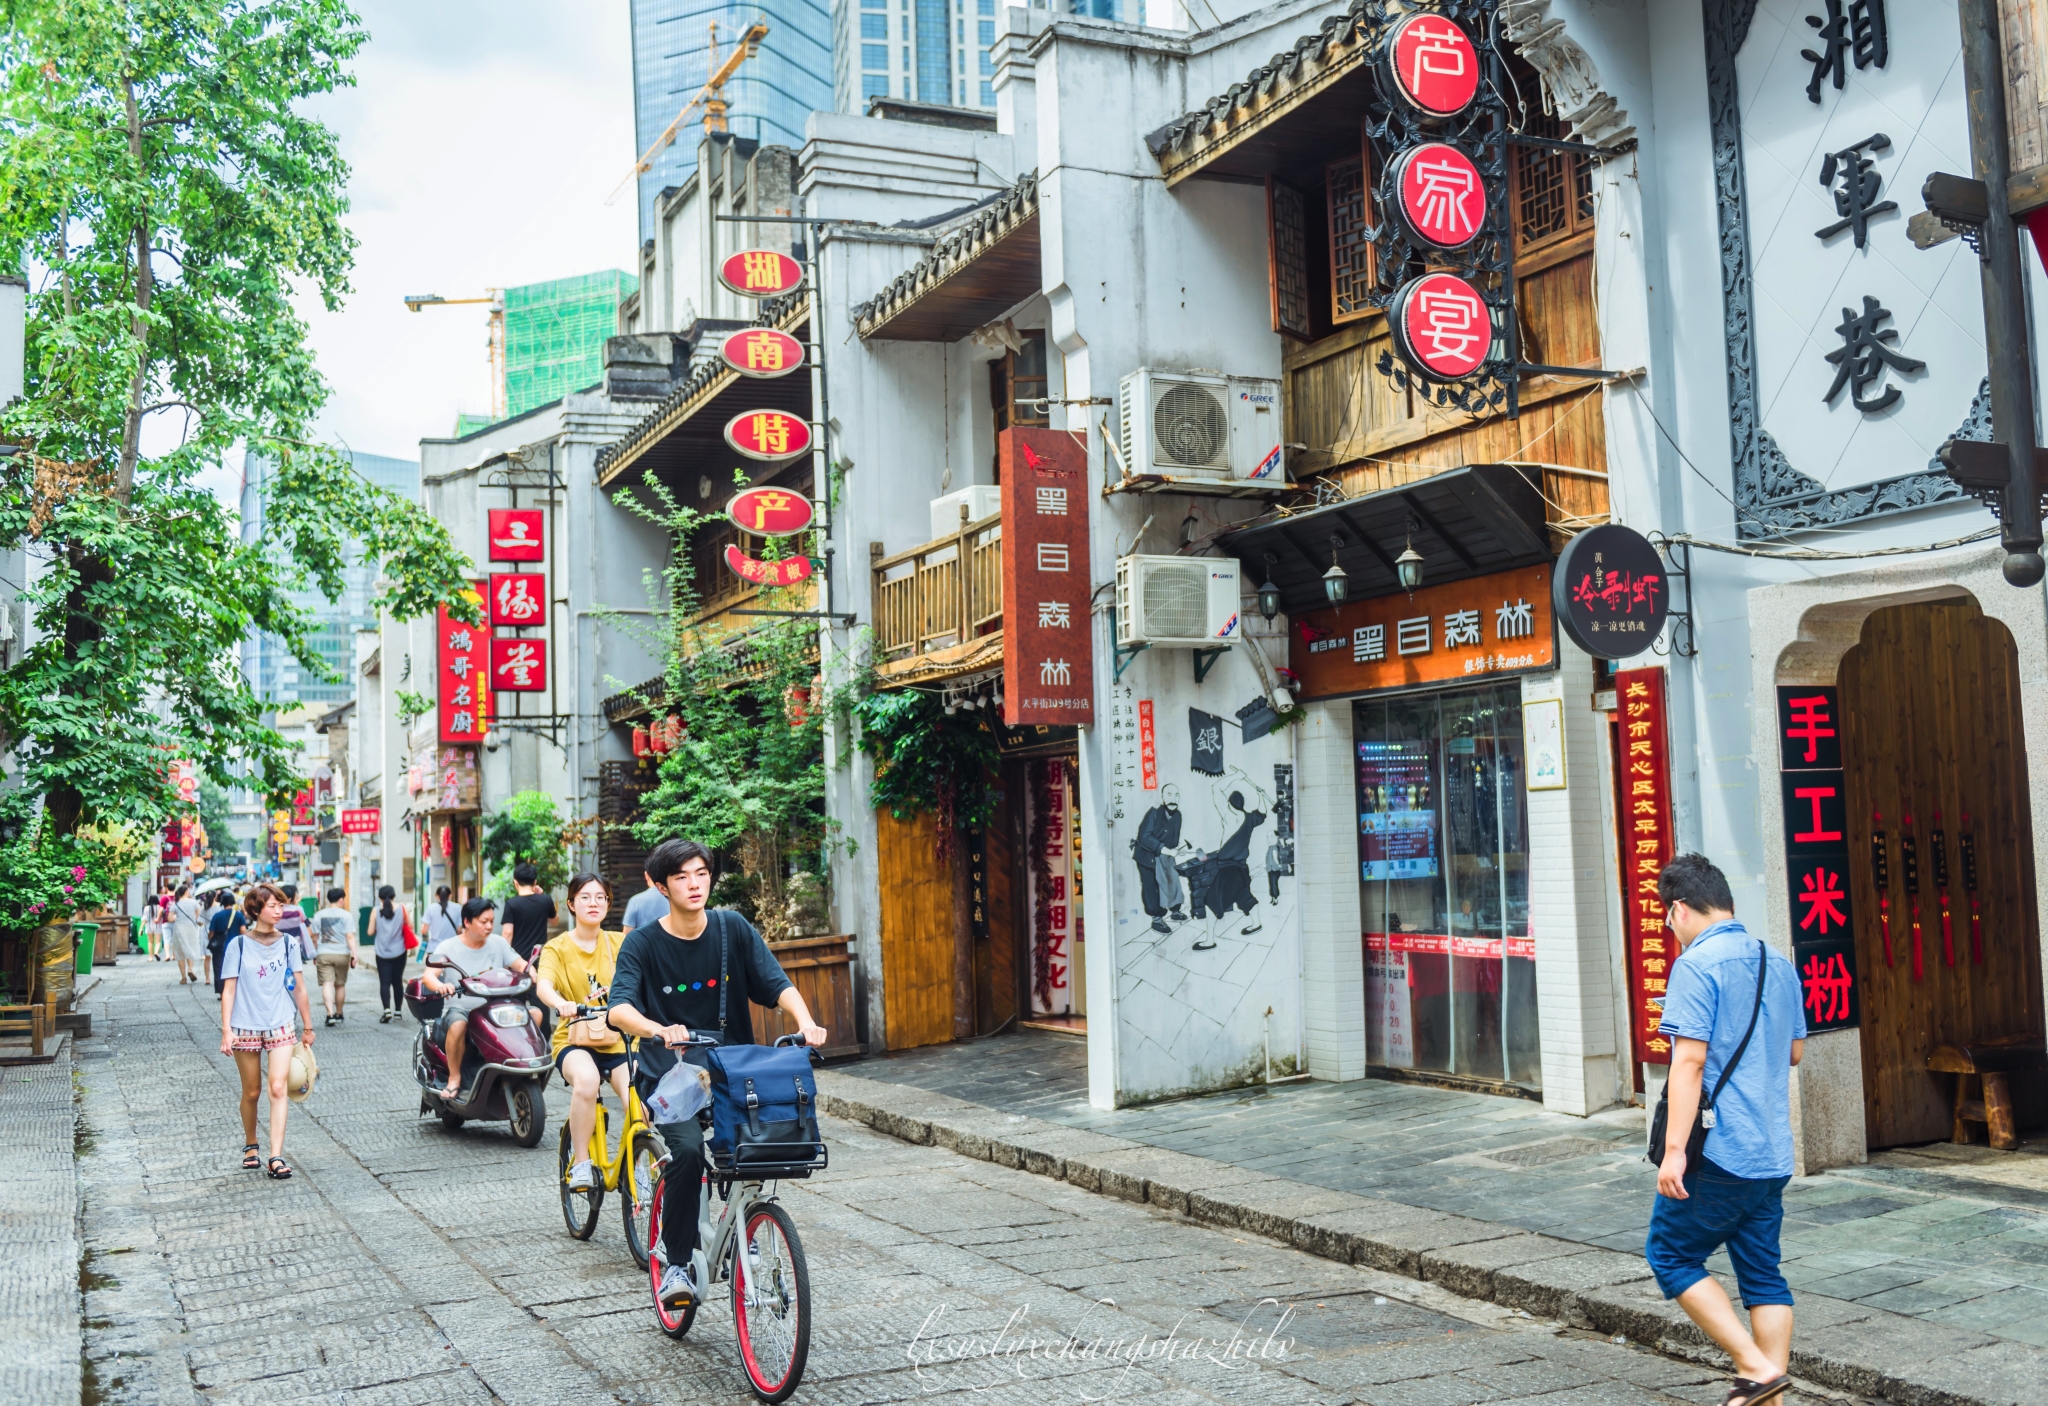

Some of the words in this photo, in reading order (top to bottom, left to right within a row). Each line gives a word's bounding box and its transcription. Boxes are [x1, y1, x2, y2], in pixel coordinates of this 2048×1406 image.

[1407, 25, 1480, 363] 芦家宴
[744, 252, 791, 530] 湖南特产
[1249, 394, 1276, 403] GREE
[1021, 697, 1089, 709] 太平街109号分店
[1786, 694, 1853, 1024] 手工米粉
